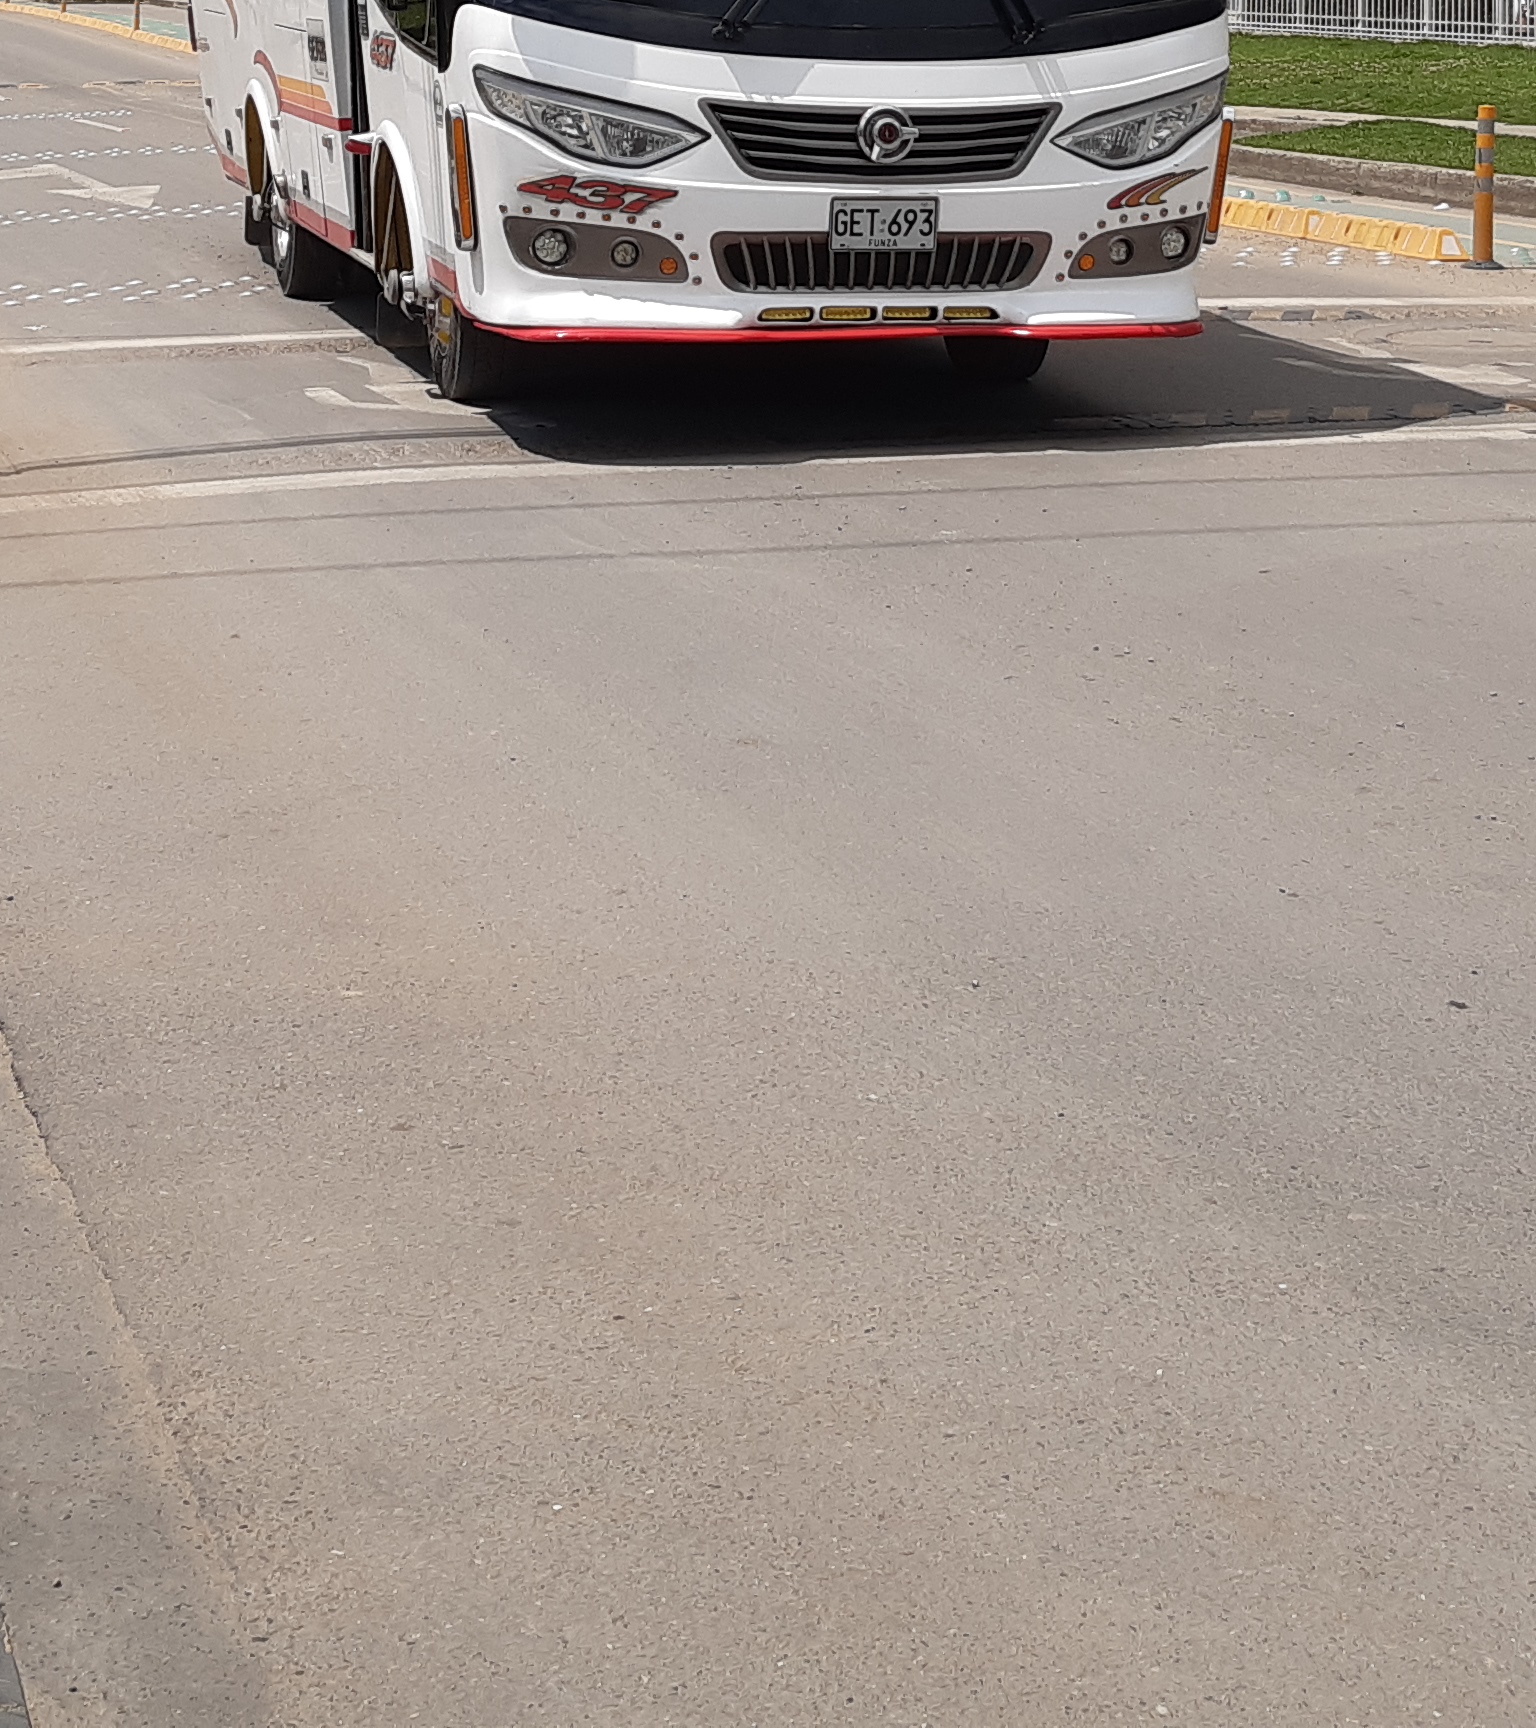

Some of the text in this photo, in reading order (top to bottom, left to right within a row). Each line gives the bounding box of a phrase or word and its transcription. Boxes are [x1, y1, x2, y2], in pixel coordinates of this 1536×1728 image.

[517, 174, 679, 214] 437
[834, 208, 934, 237] GET 693
[868, 238, 898, 247] FUNZA
